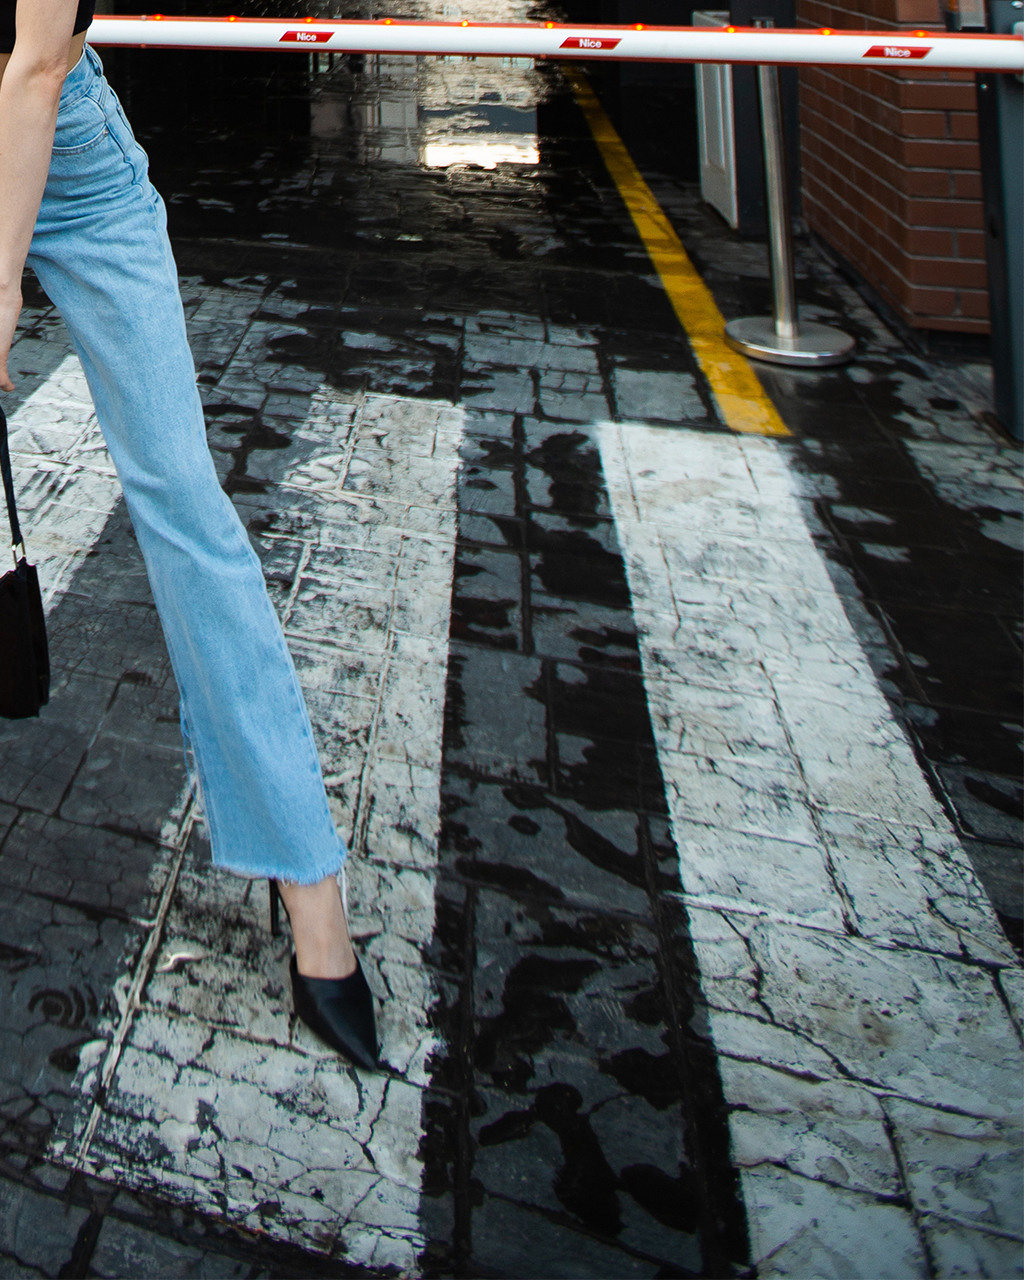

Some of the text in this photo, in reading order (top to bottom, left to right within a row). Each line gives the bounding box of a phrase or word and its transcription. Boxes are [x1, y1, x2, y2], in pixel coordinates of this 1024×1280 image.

[296, 32, 317, 41] Nice
[579, 38, 602, 48] Nice
[884, 47, 911, 57] Nice
